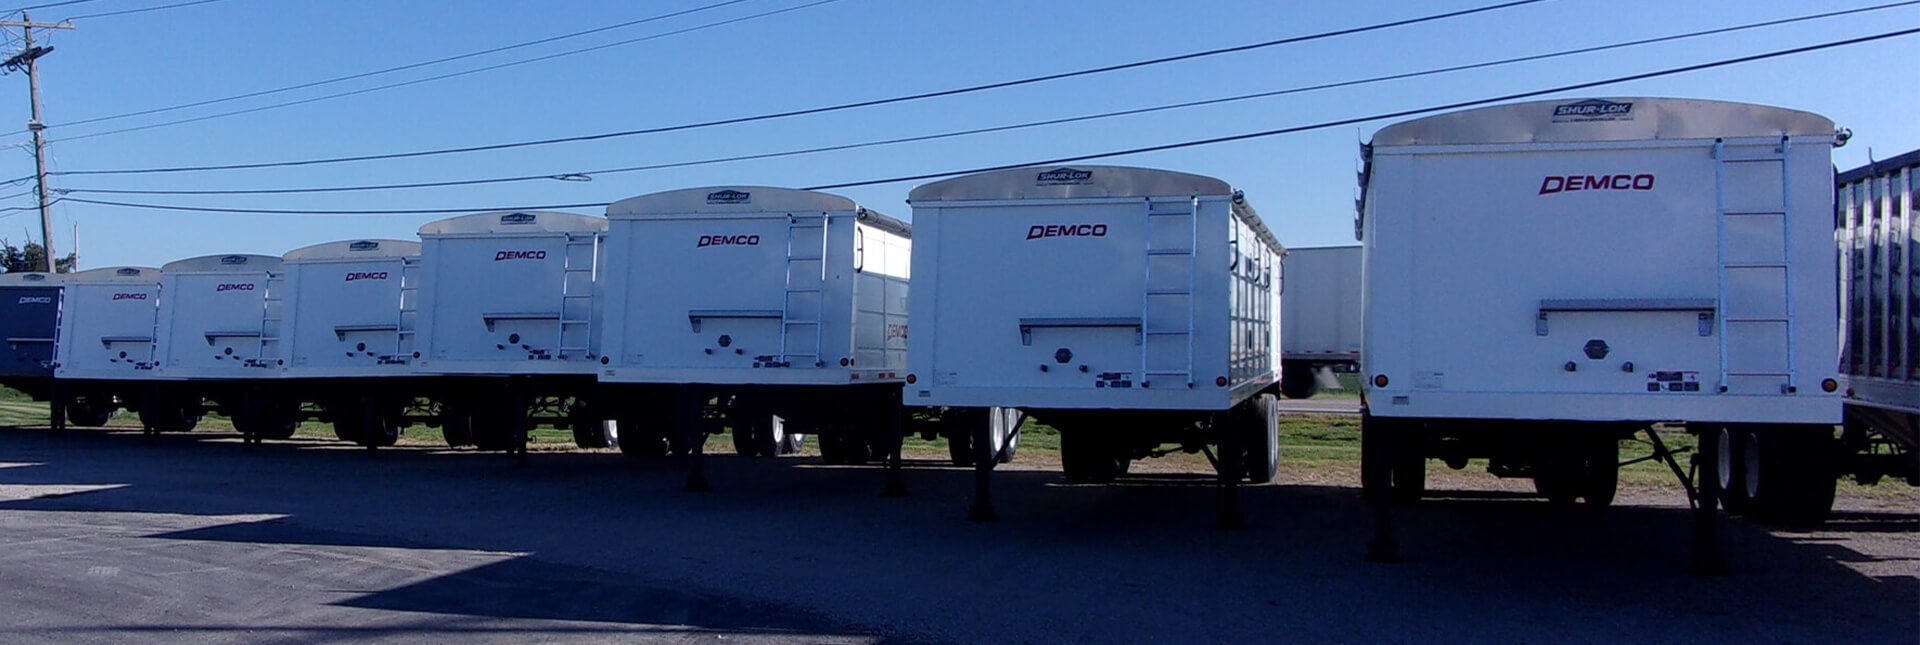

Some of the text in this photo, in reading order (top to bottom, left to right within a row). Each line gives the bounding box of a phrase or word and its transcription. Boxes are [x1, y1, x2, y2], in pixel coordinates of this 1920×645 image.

[1557, 103, 1629, 116] SHUR-LOK
[1538, 174, 1655, 196] DEMCO
[1026, 224, 1108, 241] DEMCO
[696, 234, 760, 248] DEMCO
[494, 250, 547, 262] DEMCO
[345, 271, 388, 282] DEMCO
[216, 283, 255, 292] DEMCO
[18, 296, 52, 304] DEMCO
[112, 293, 148, 301] DEMCO
